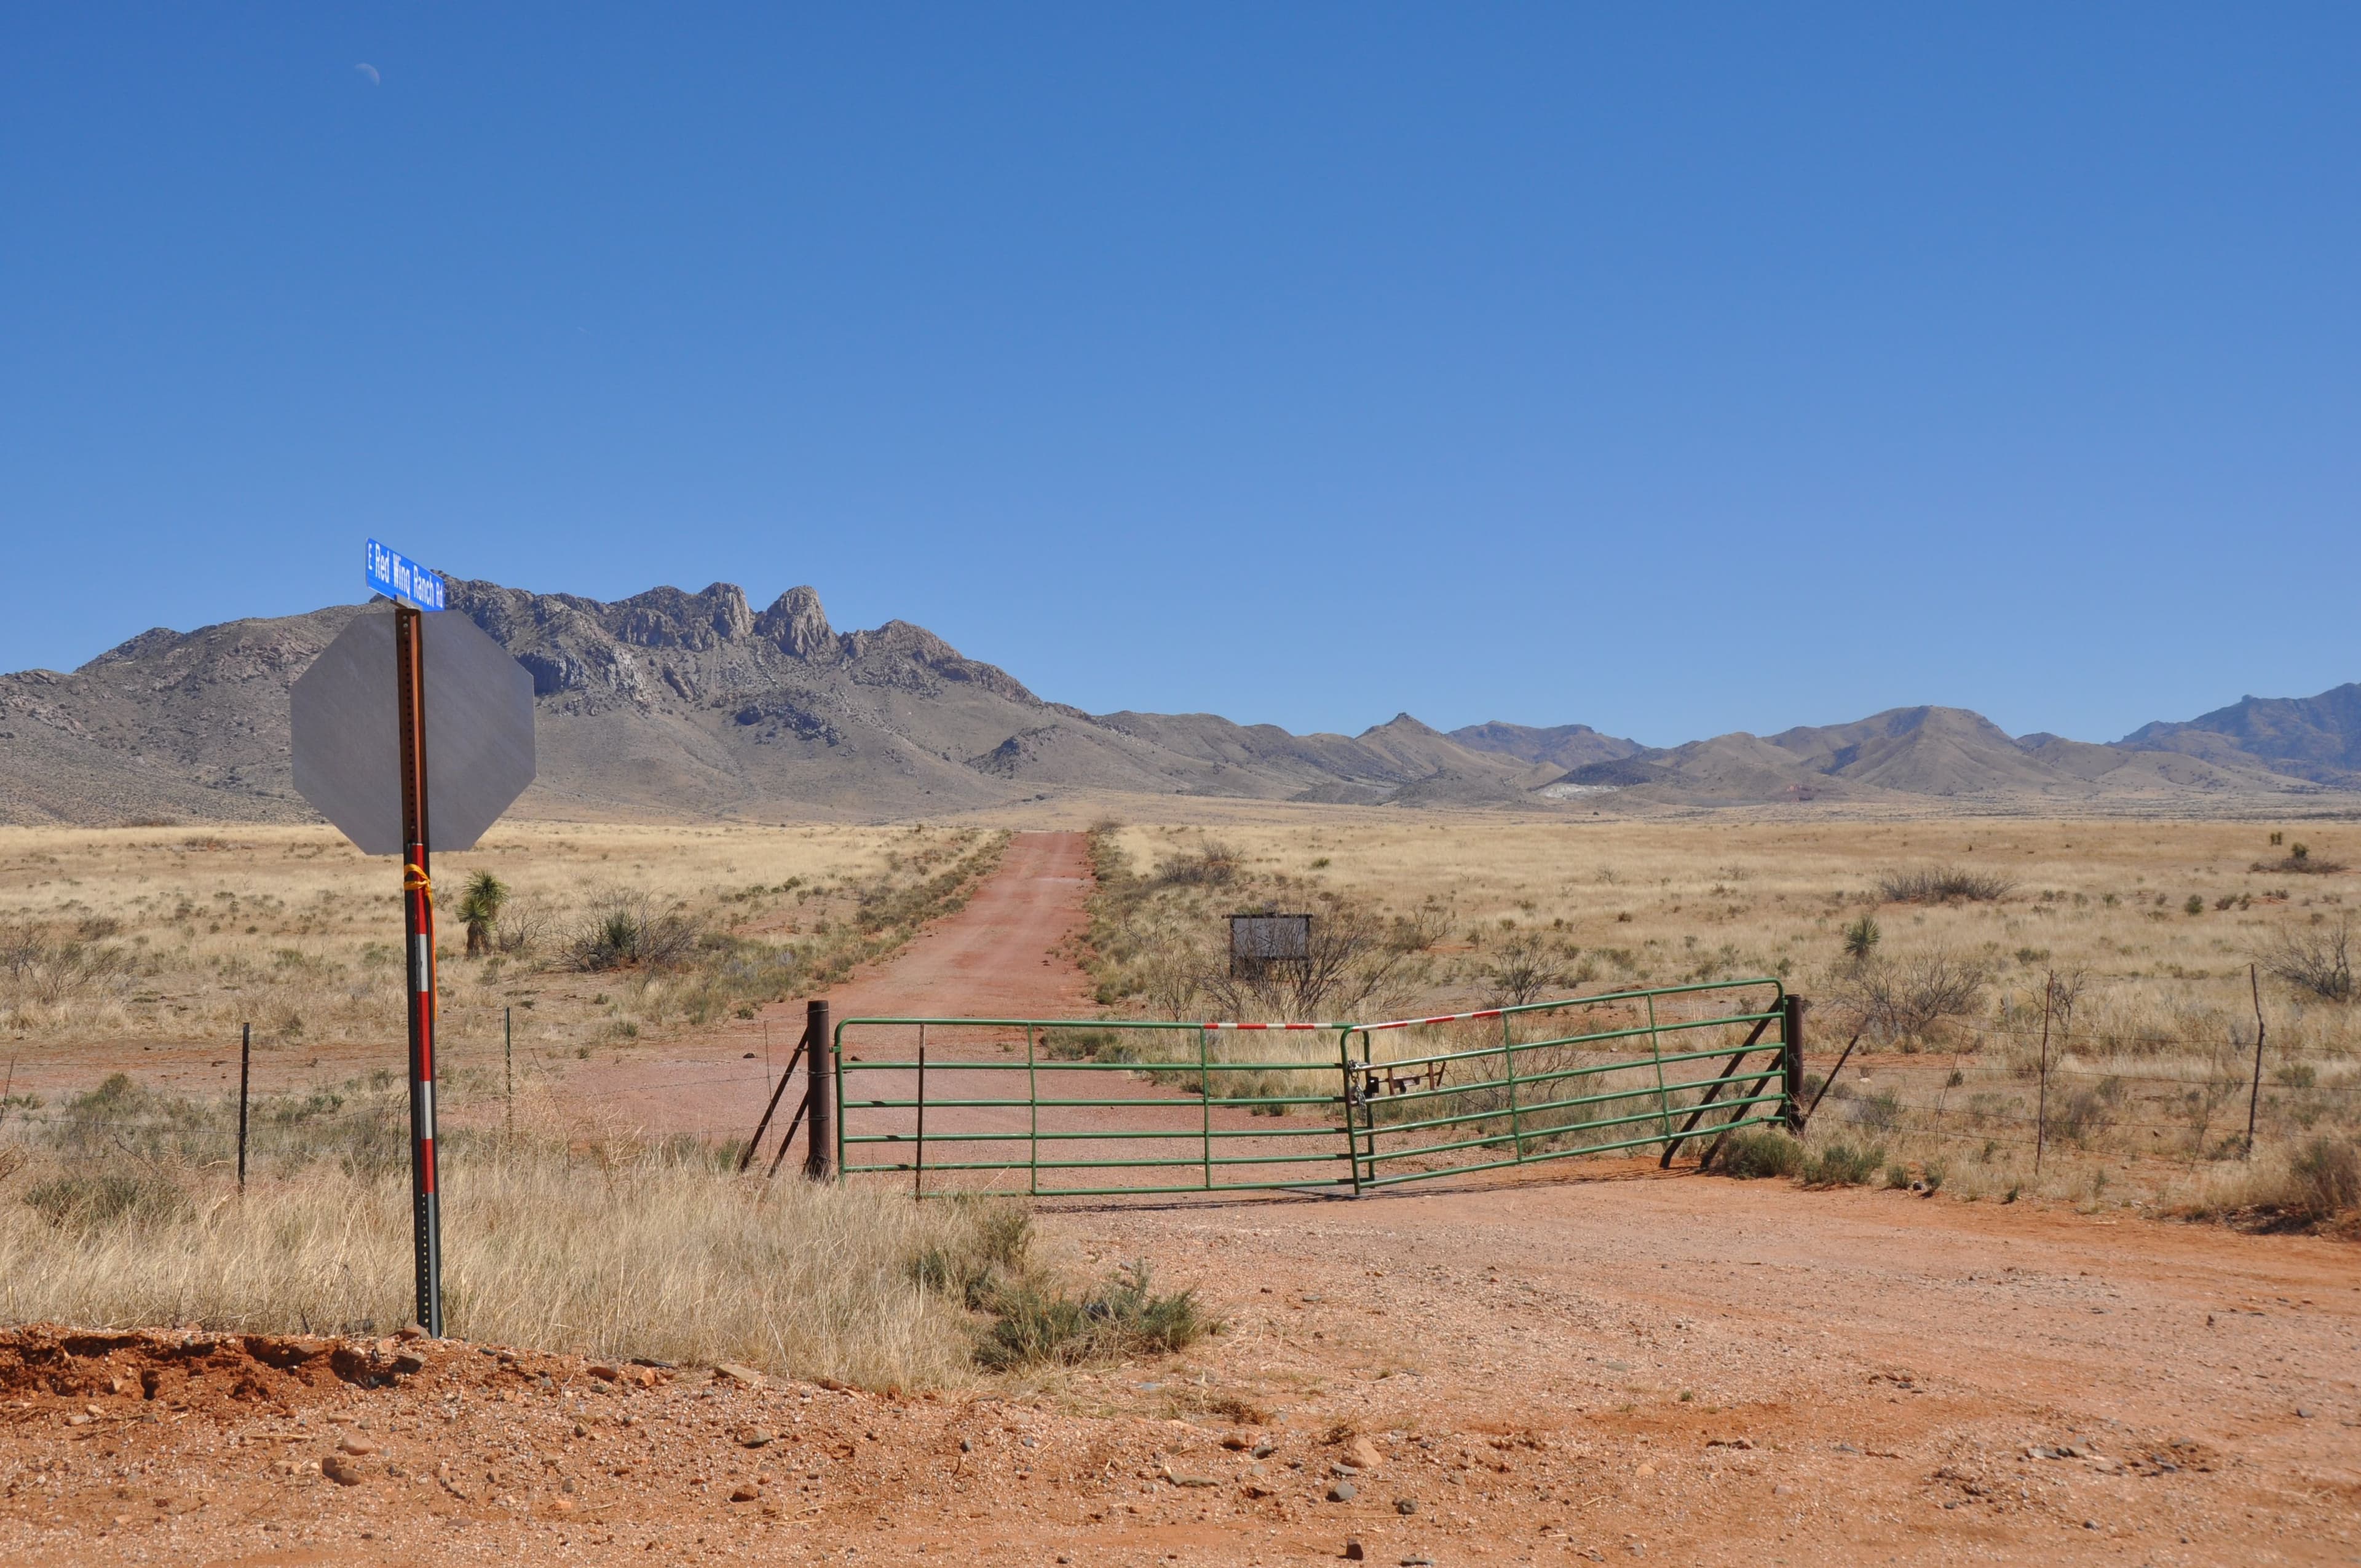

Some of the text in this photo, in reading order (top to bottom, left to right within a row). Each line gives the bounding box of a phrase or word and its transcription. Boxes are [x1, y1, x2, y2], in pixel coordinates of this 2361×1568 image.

[368, 543, 443, 608] E Red Wing Ranch Rd
